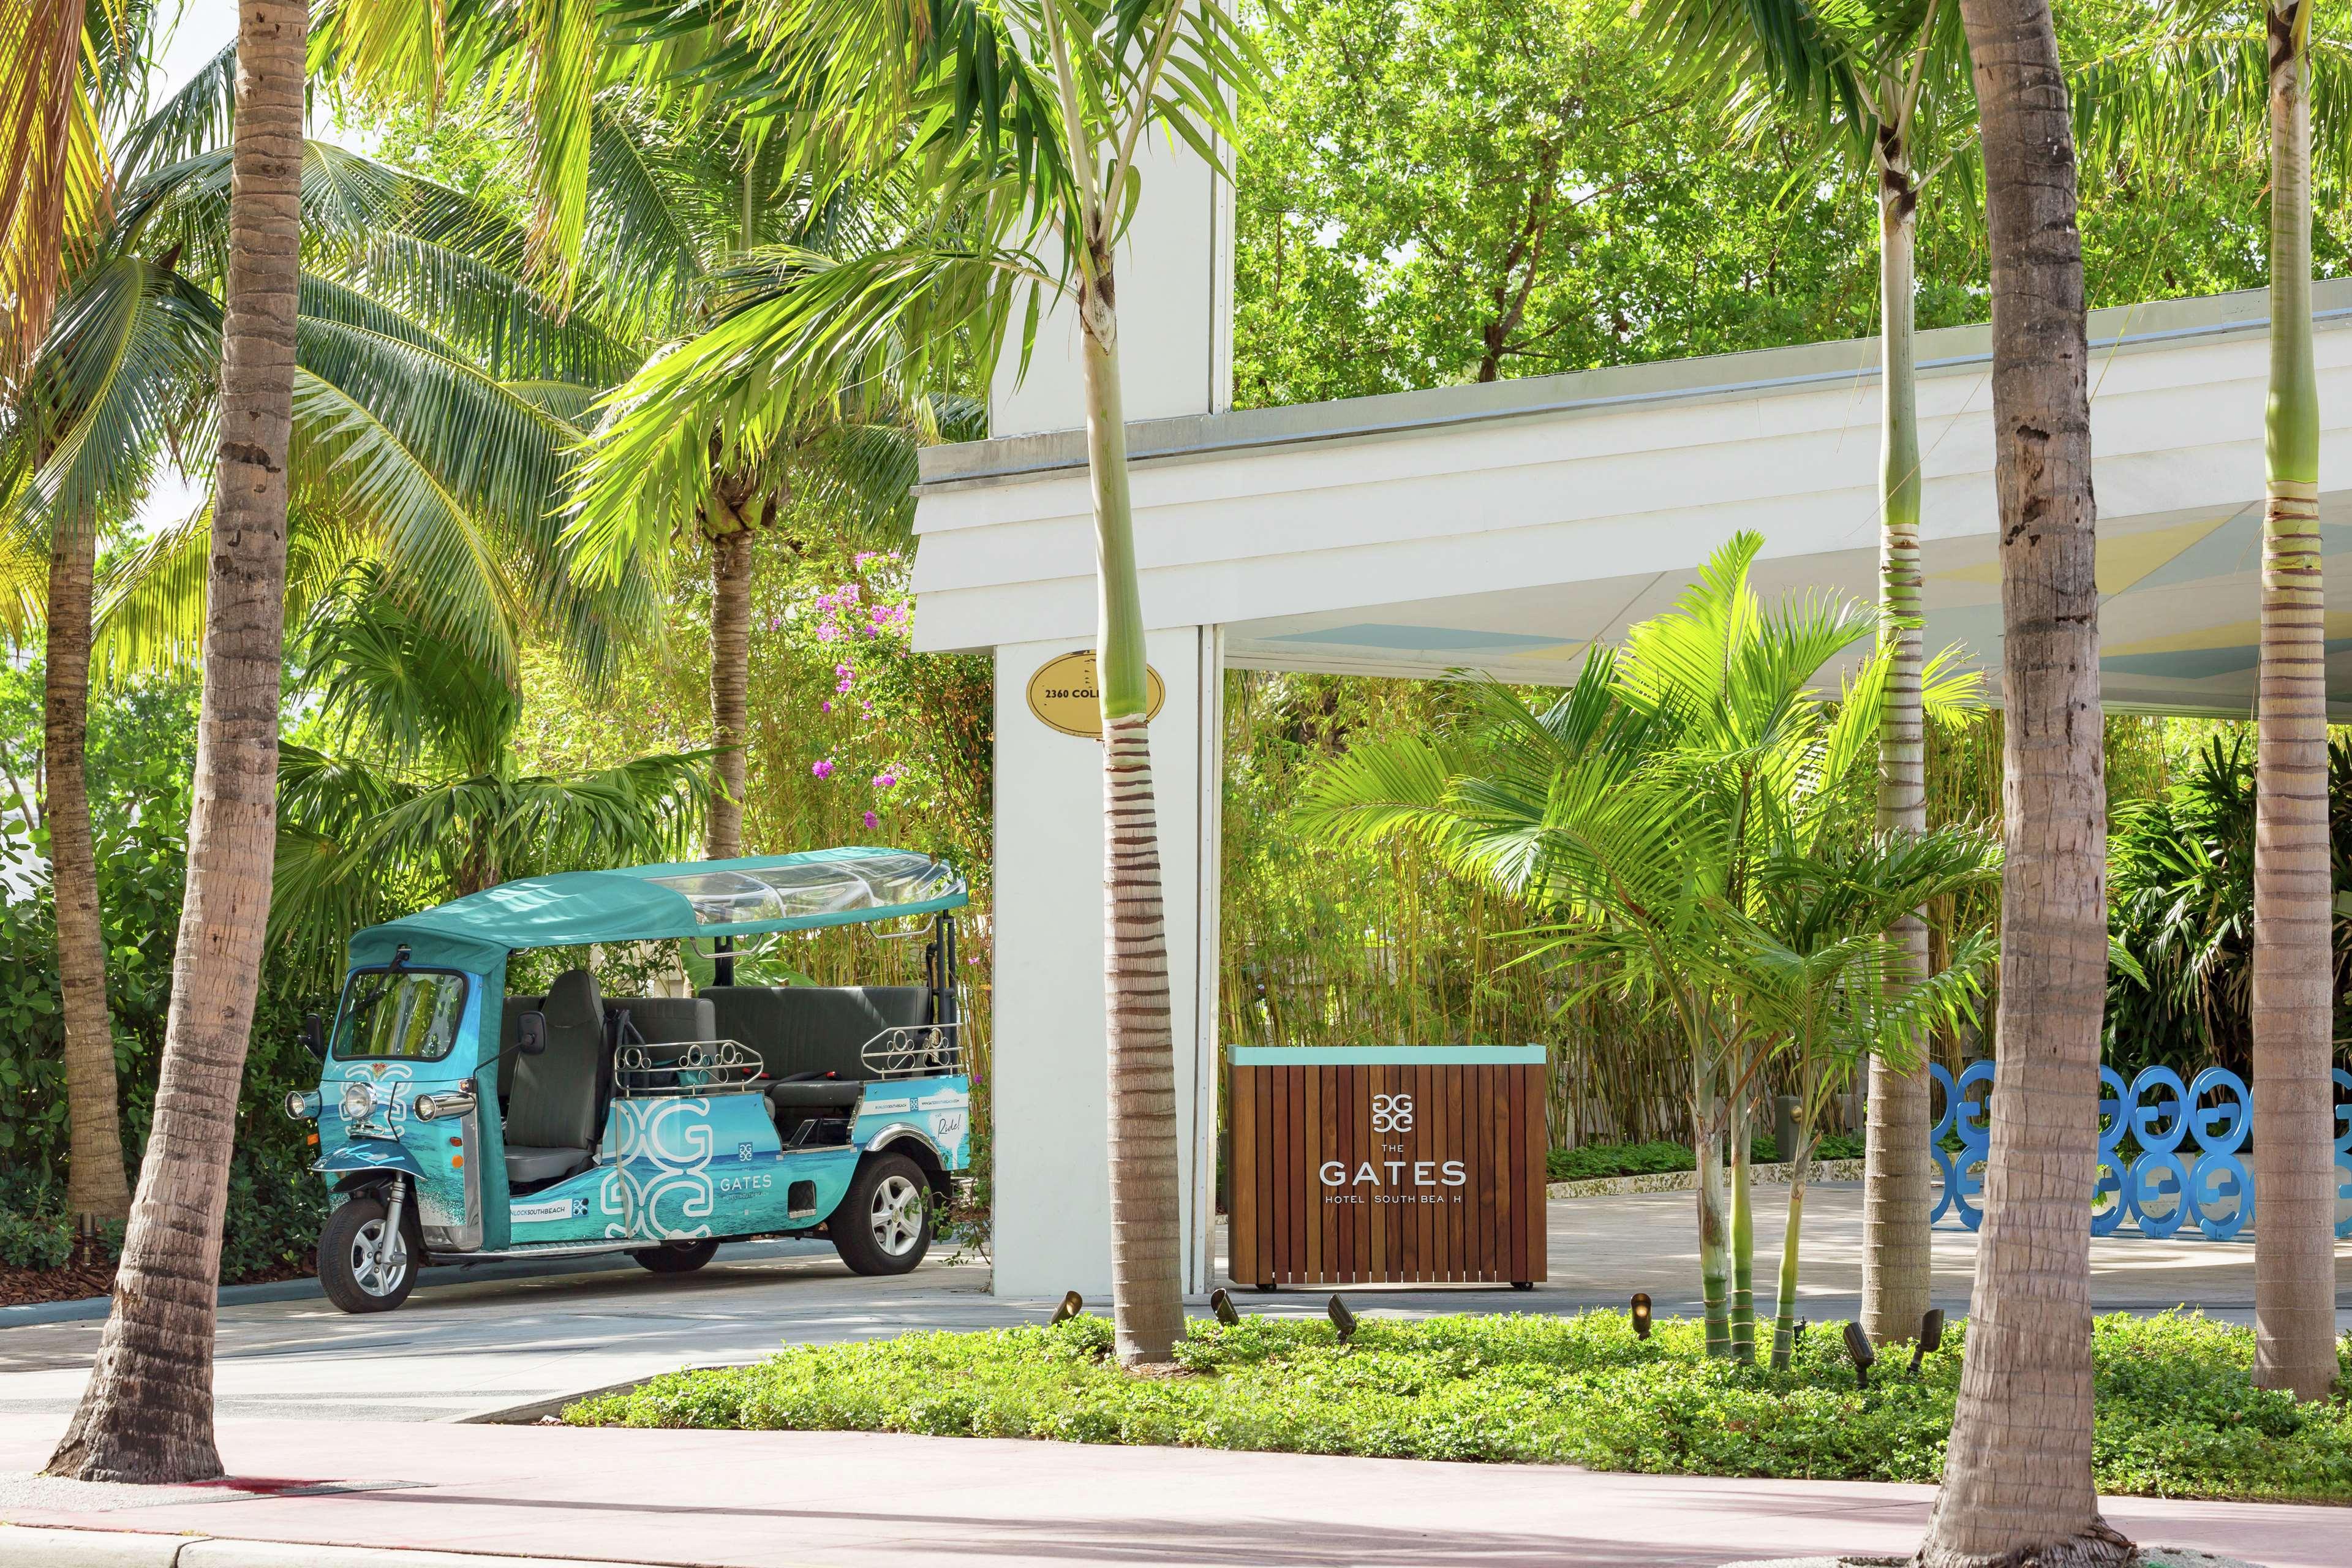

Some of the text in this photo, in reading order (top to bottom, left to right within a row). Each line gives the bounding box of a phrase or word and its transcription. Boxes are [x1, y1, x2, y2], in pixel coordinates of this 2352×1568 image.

[1046, 689, 1069, 698] 2360
[938, 1114, 961, 1139] Ride!
[1381, 1144, 1404, 1153] THE
[1319, 1161, 1467, 1186] GATES
[720, 1174, 772, 1192] GATES
[1325, 1196, 1365, 1204] HOTEL
[1374, 1195, 1415, 1204] SOUTH
